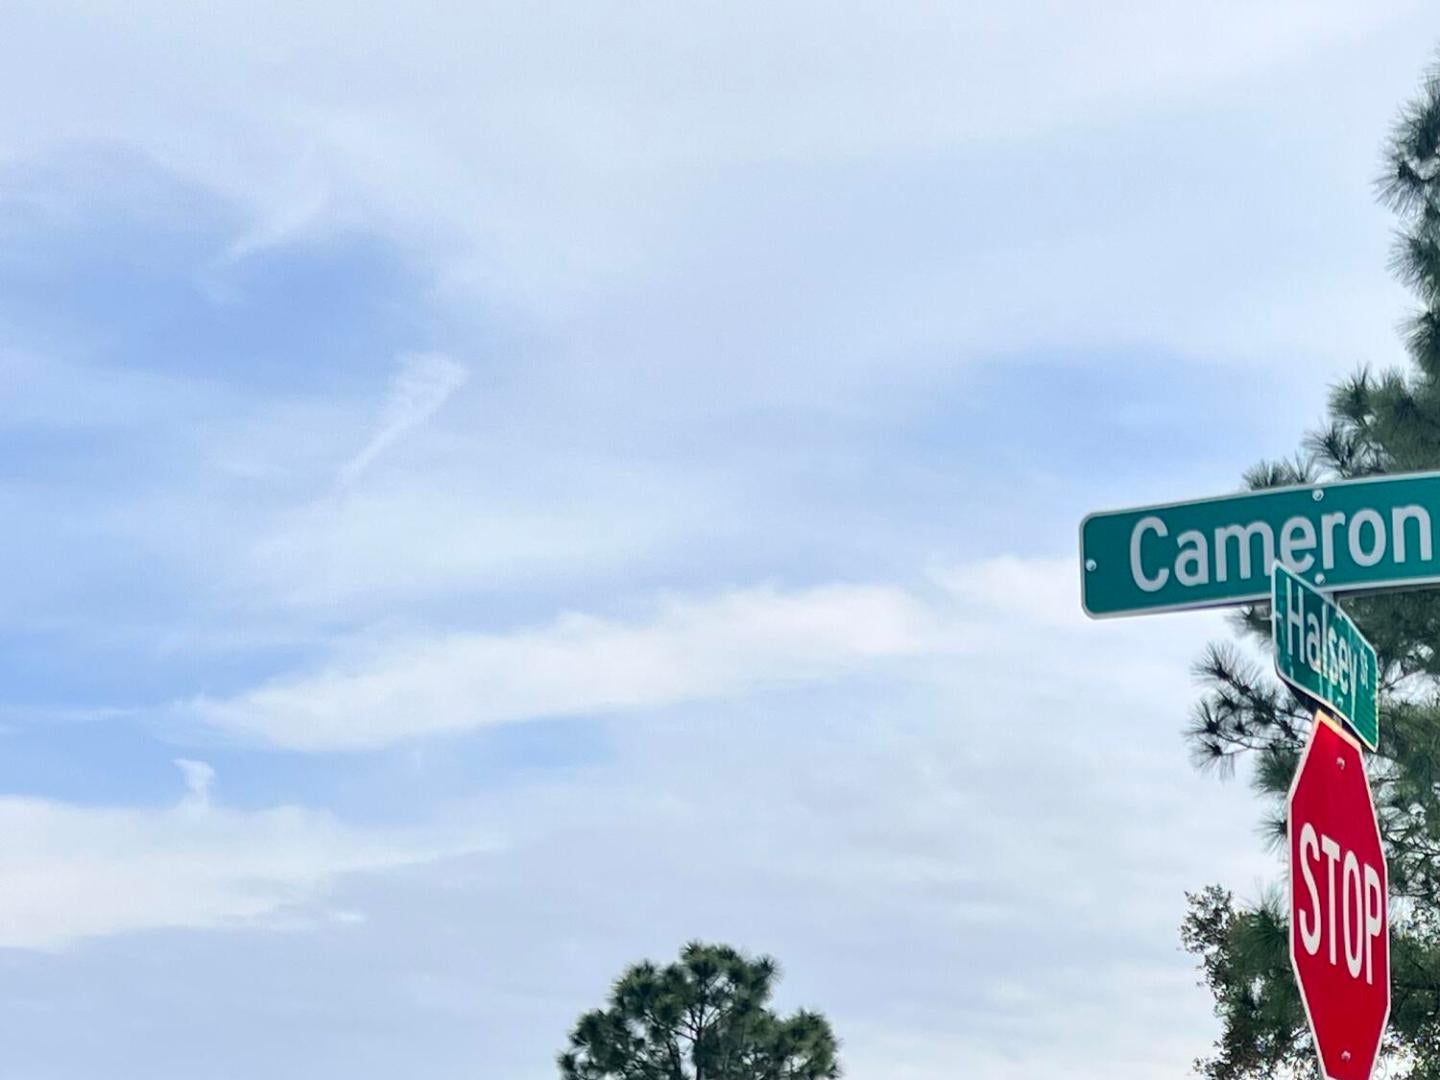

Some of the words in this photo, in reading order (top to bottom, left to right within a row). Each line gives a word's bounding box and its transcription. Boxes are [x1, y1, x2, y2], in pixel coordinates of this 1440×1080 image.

[1130, 504, 1432, 592] Cameron
[1286, 576, 1358, 722] Halsey
[1298, 822, 1383, 984] STOP
